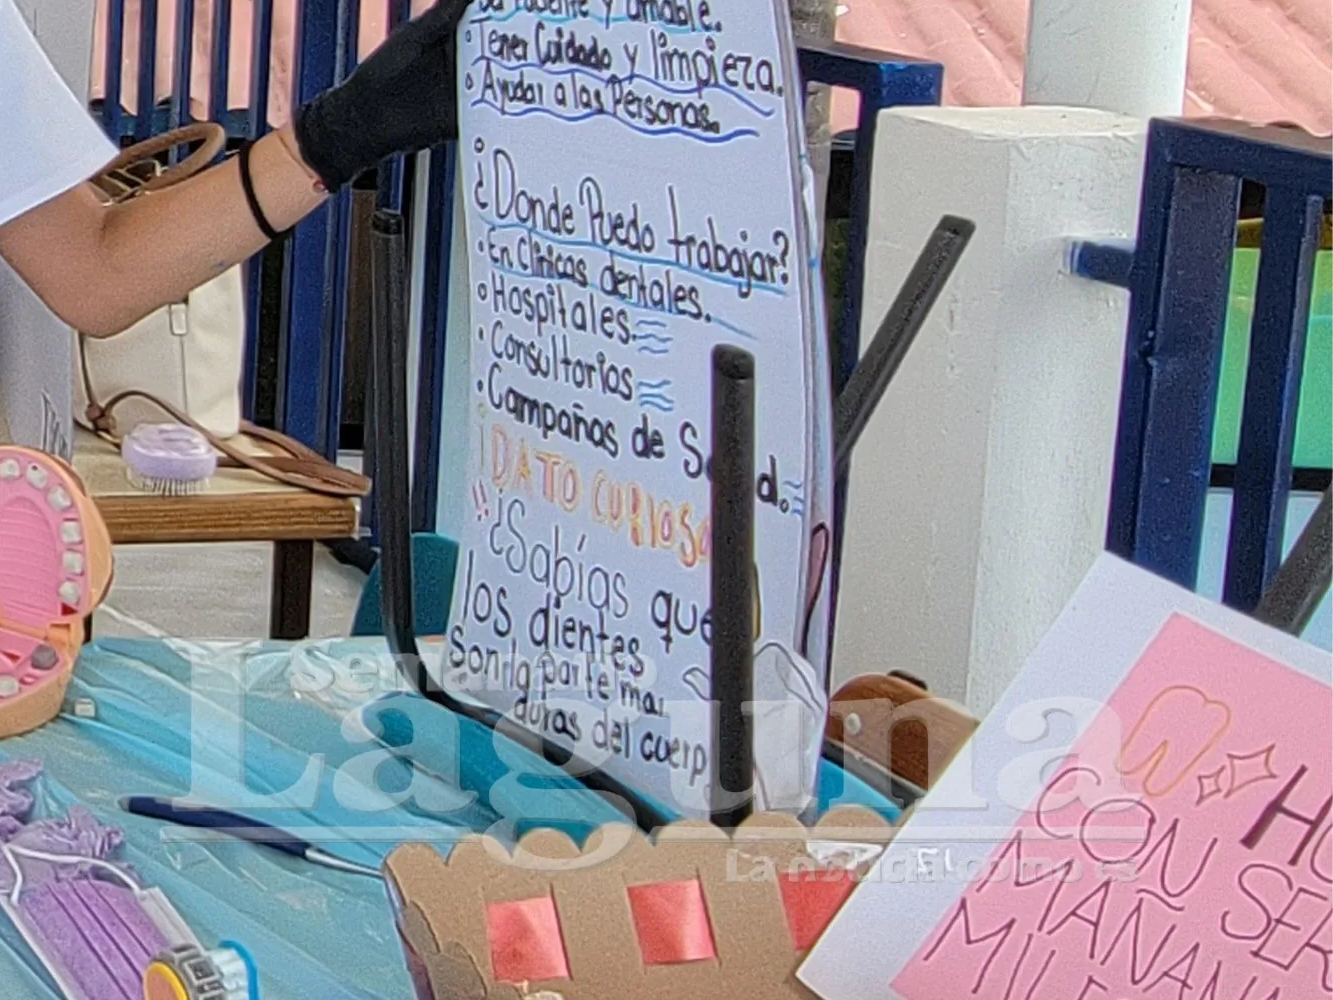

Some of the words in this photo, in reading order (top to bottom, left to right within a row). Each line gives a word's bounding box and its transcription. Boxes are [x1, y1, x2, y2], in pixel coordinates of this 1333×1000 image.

[555, 82, 567, 107] a
[572, 71, 604, 114] las
[623, 43, 638, 84] y
[668, 185, 790, 299] trabajar?
[631, 412, 666, 459] de
[463, 550, 512, 638] los
[529, 592, 646, 677] dientes
[592, 706, 631, 759] del
[639, 731, 711, 788] cuerp
[1036, 766, 1218, 897] CON
